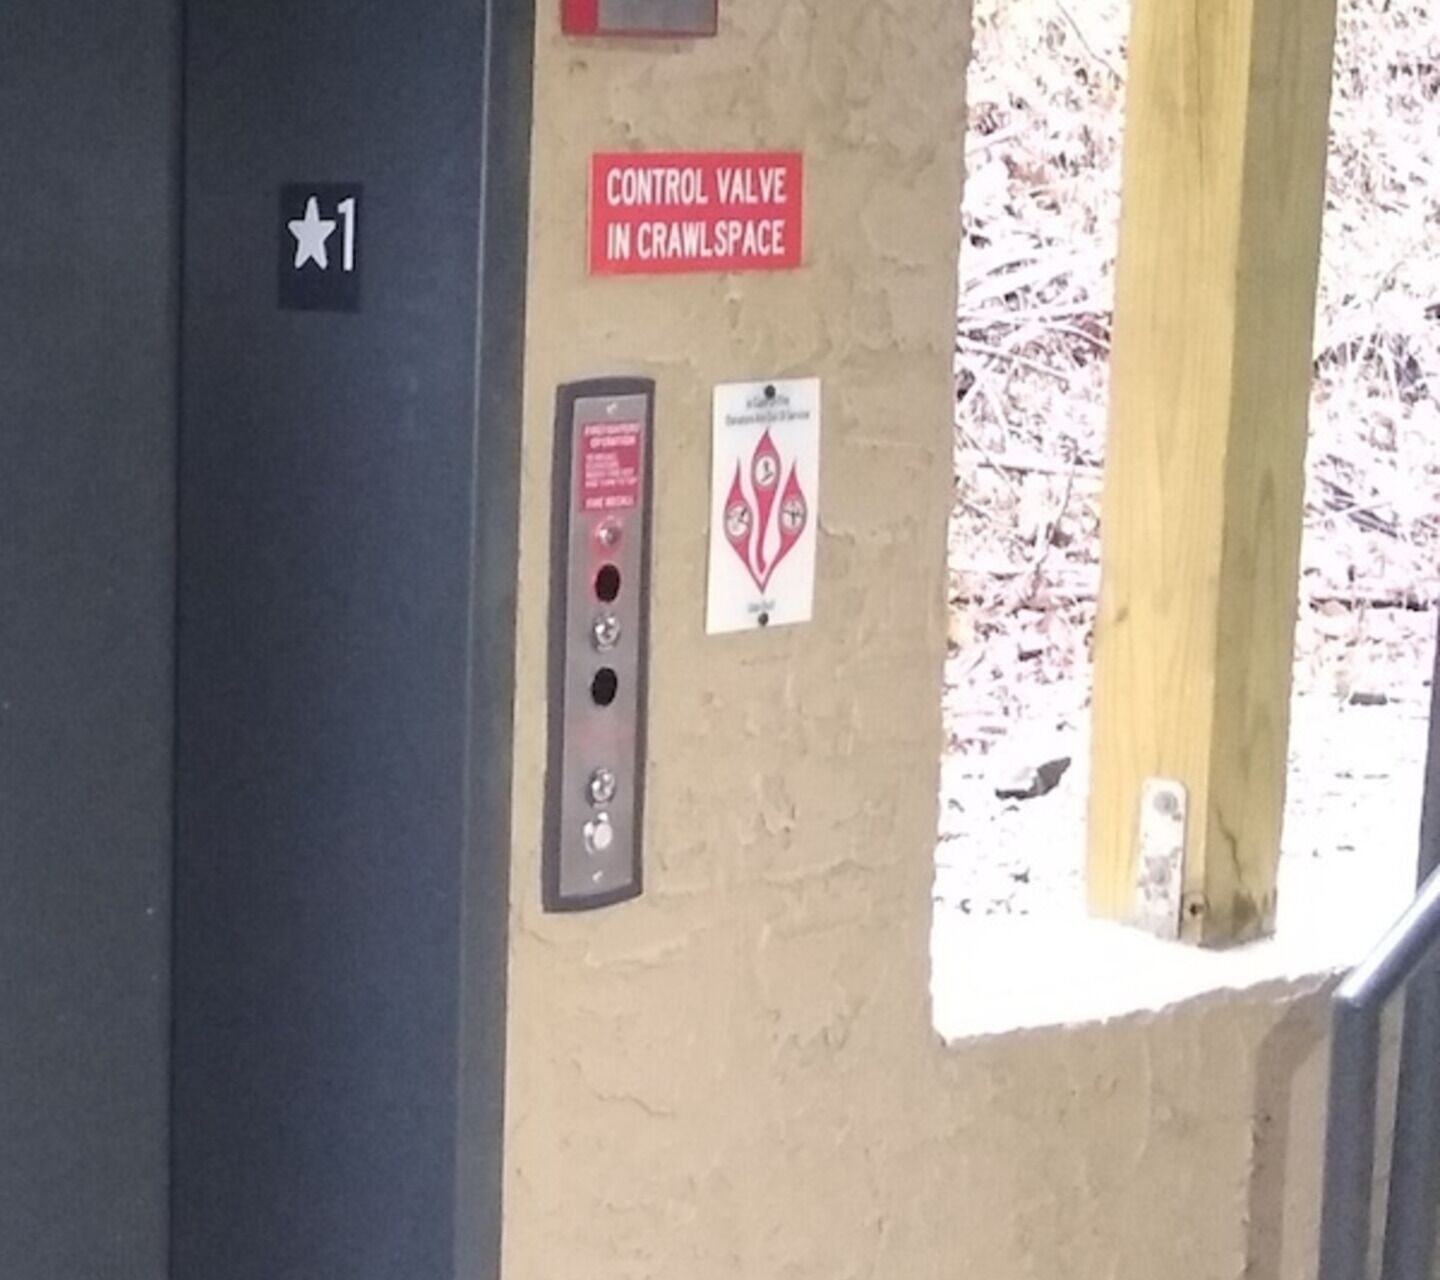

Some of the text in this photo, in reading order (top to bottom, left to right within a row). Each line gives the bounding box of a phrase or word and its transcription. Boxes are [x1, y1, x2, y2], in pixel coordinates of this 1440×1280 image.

[607, 167, 787, 206] CONTROL VALVE
[337, 197, 355, 271] 1
[607, 222, 630, 260] IN
